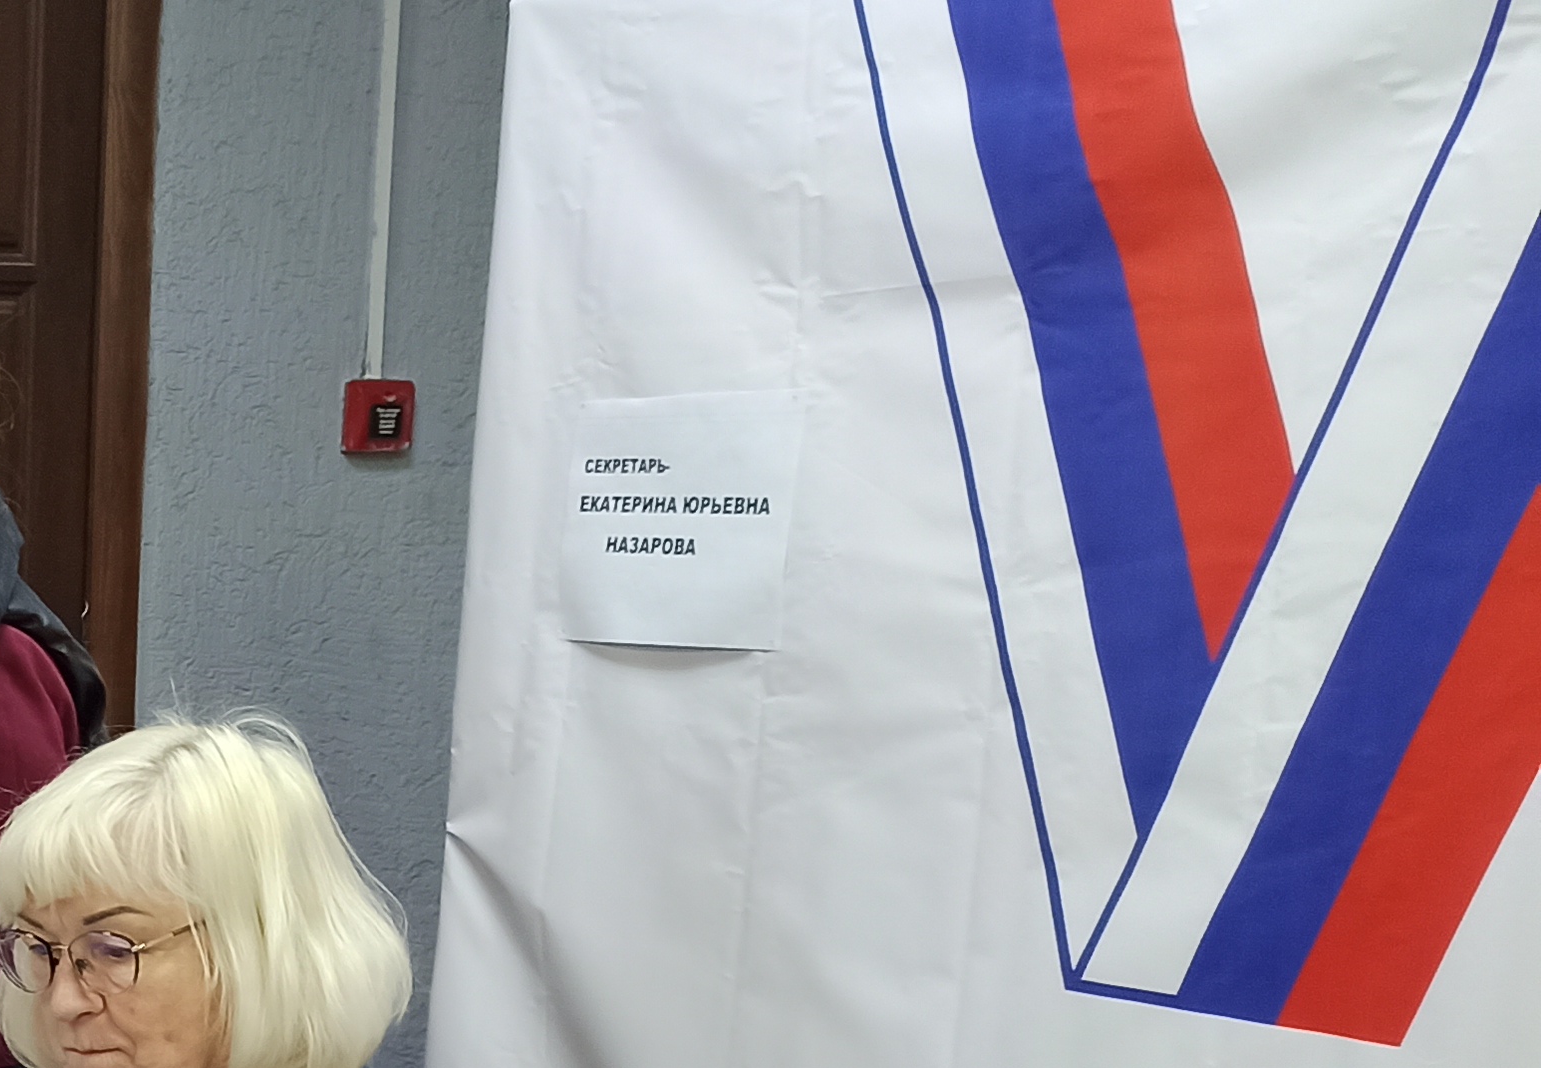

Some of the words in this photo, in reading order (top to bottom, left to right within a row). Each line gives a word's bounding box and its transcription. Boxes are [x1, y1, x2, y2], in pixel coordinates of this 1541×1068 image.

[584, 458, 670, 474] СЕКРЕТАРЬ-
[579, 496, 677, 514] ЕКАТЕРИНА
[682, 496, 771, 515] ЮРЬЕВНА
[605, 536, 696, 556] НАЗАРОВА
